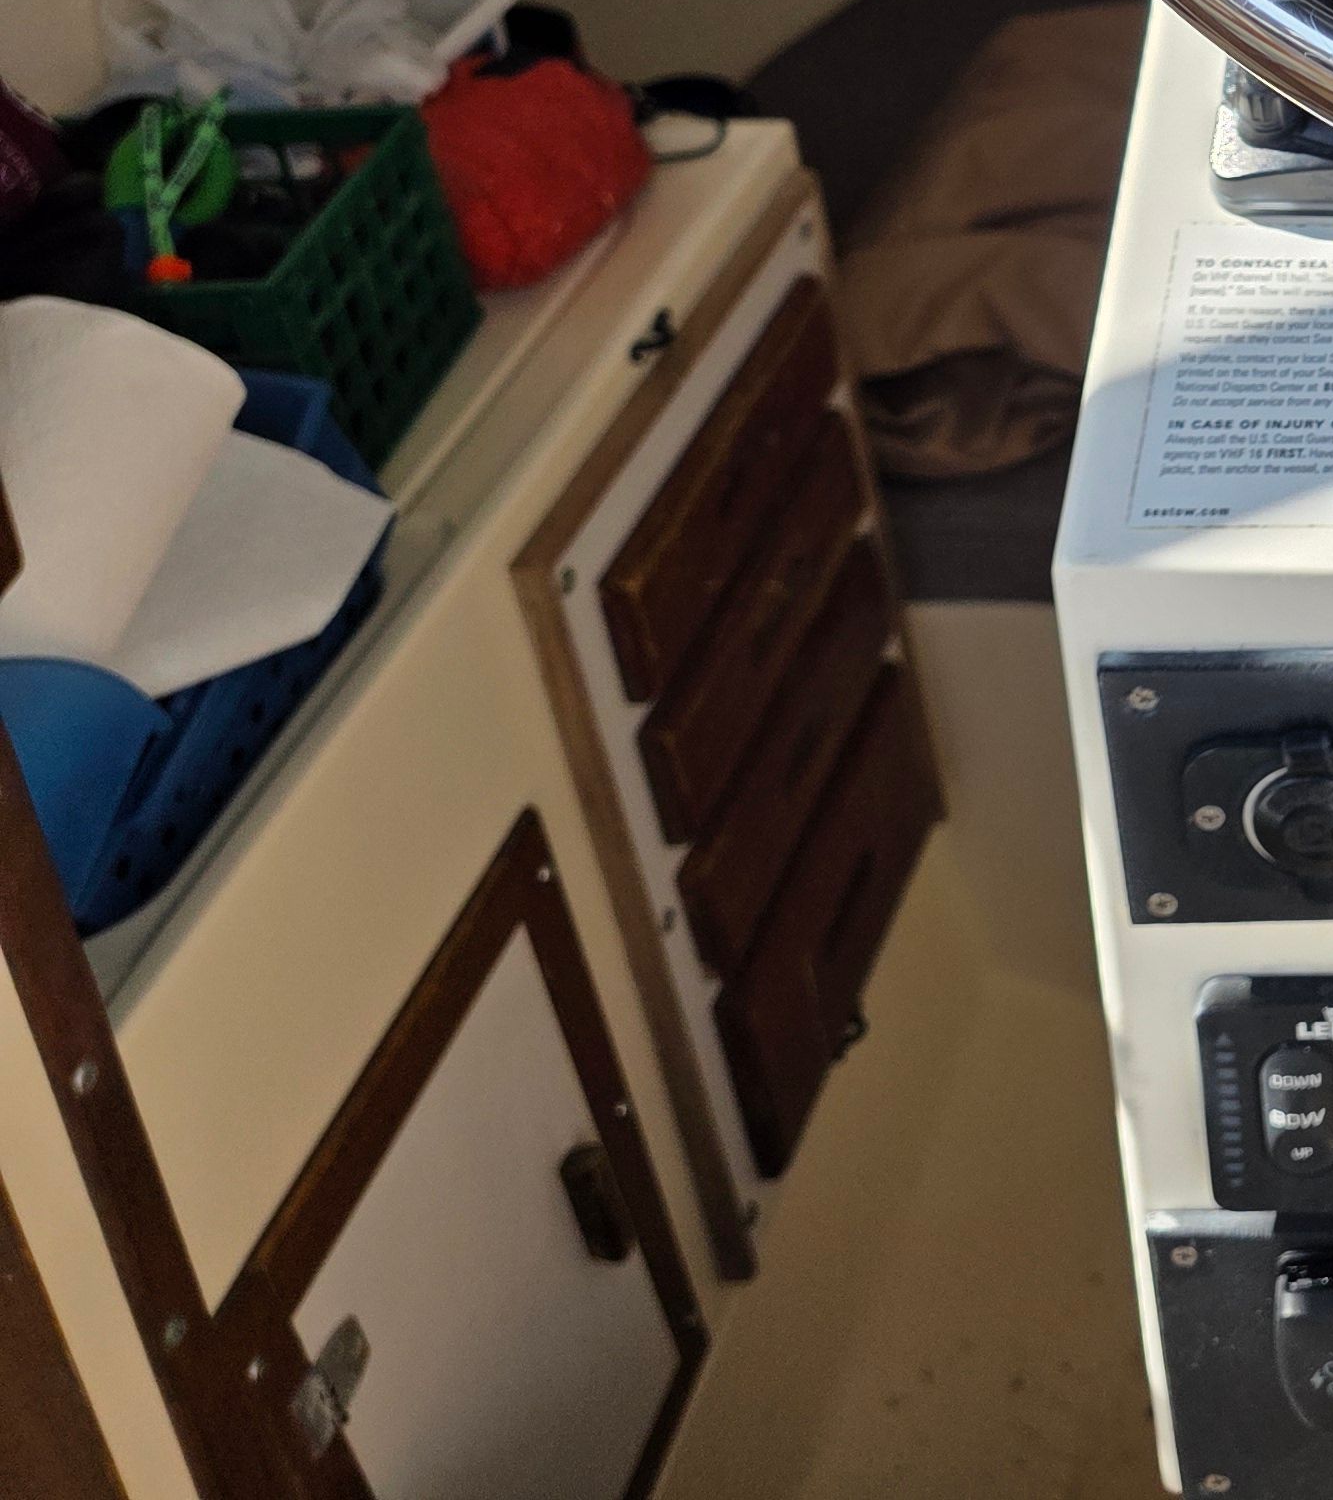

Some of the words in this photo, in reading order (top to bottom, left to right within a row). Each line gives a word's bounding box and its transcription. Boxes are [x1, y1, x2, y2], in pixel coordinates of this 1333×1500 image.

[1196, 258, 1215, 269] TO
[1221, 258, 1293, 269] CONTACT
[1298, 259, 1328, 269] SEA
[1167, 419, 1185, 430] IN
[1191, 419, 1234, 430] CASE
[1239, 419, 1260, 430] OF
[1265, 419, 1325, 429] INJURY
[1229, 434, 1247, 444] the
[1273, 434, 1304, 444] Coast
[1220, 449, 1246, 459] VHF
[1250, 449, 1264, 459] 16
[1265, 448, 1306, 459] FIRST.
[1143, 507, 1230, 517] seatow.com
[1267, 1072, 1323, 1090] DOWN
[1267, 1106, 1326, 1130] BOW
[1290, 1145, 1314, 1161] UP
